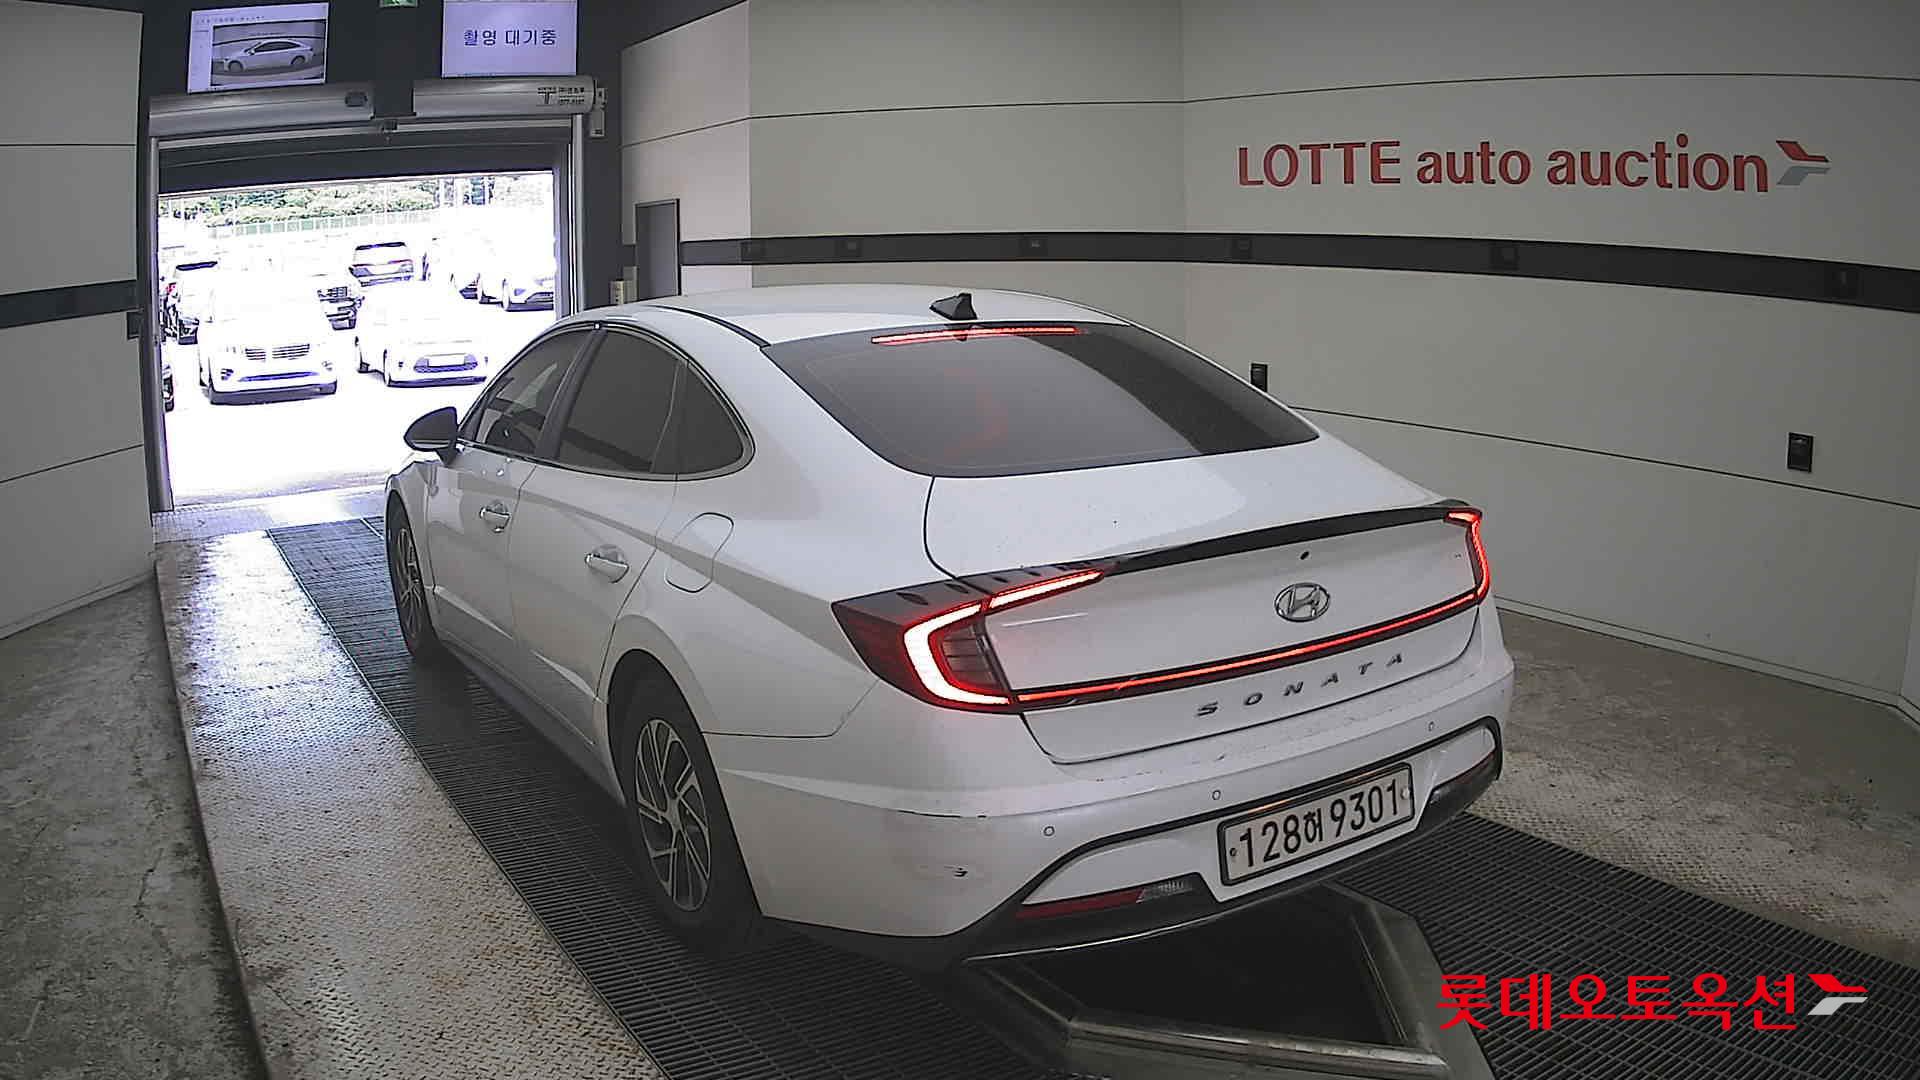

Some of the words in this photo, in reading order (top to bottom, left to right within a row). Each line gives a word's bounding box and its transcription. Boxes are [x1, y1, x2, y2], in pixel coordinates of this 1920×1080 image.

[504, 29, 557, 46] 대기중
[1239, 141, 1400, 187] LOTTE
[1417, 141, 1531, 186] auto
[1547, 133, 1769, 193] auction
[1197, 653, 1402, 716] SONATA
